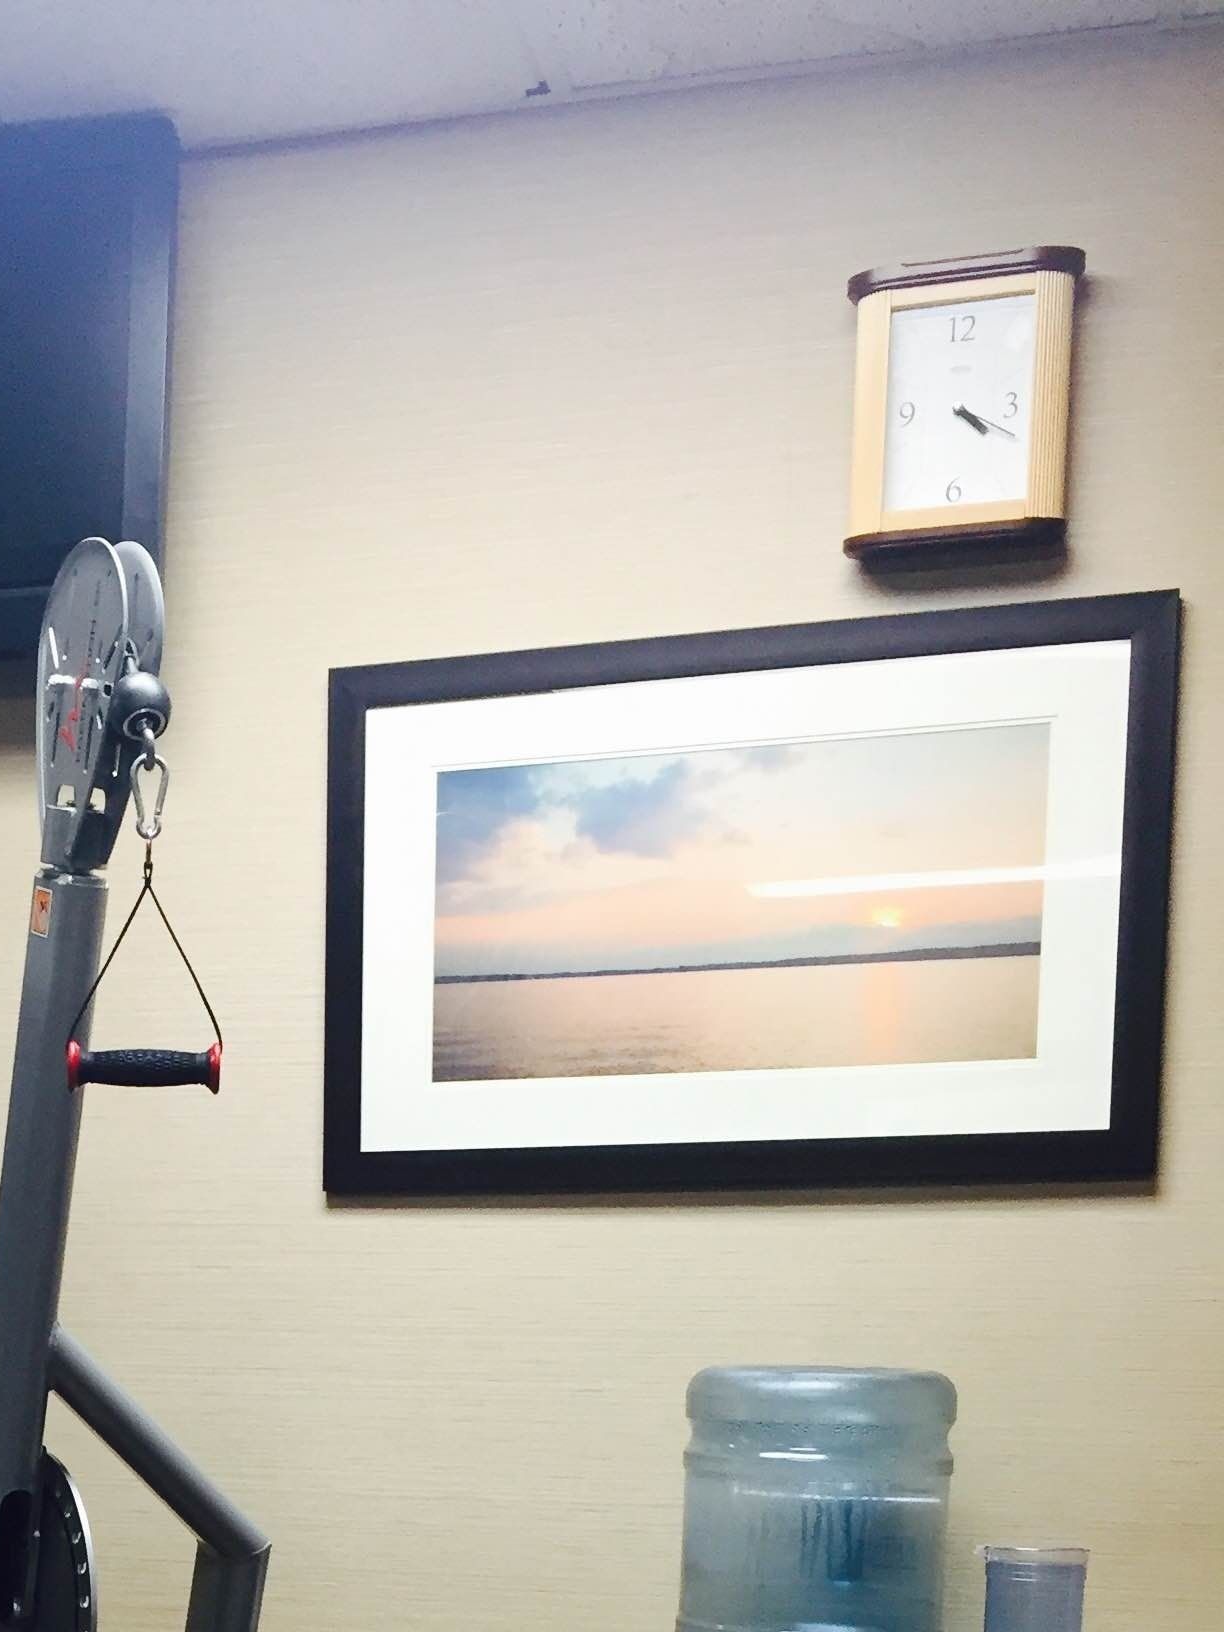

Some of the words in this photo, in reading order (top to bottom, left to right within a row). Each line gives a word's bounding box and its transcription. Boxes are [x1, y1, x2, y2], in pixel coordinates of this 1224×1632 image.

[948, 315, 976, 343] 12
[899, 401, 916, 427] 9
[1003, 391, 1019, 419] 3
[945, 477, 963, 504] 6
